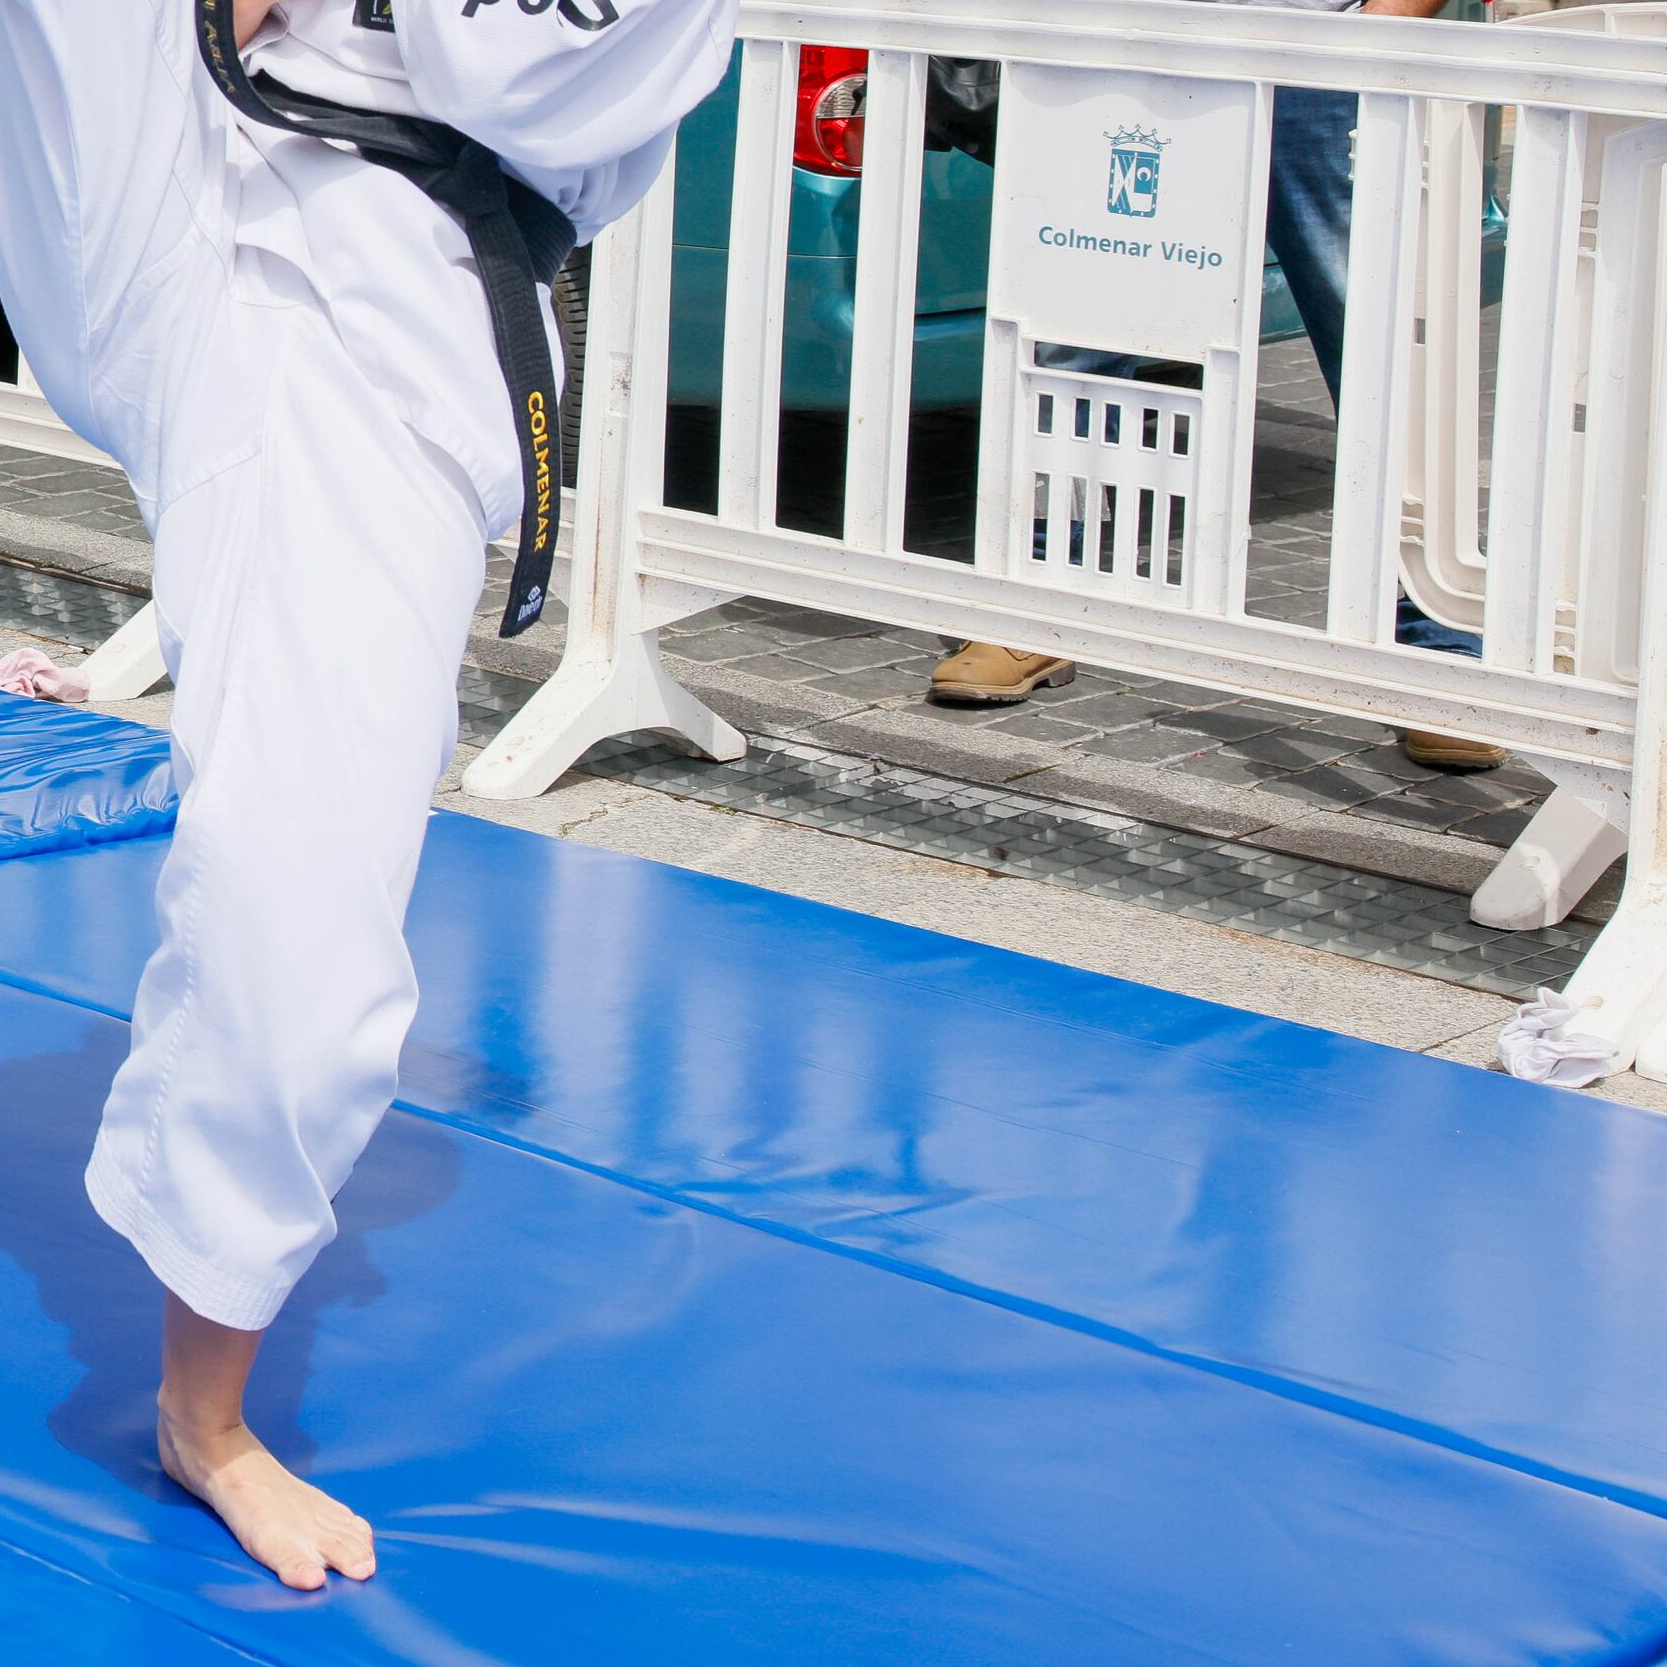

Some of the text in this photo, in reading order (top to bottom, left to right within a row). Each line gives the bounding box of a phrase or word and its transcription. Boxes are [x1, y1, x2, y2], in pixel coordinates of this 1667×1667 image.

[1038, 226, 1223, 270] Colmenar Viejo
[527, 390, 553, 553] COLMENAR
